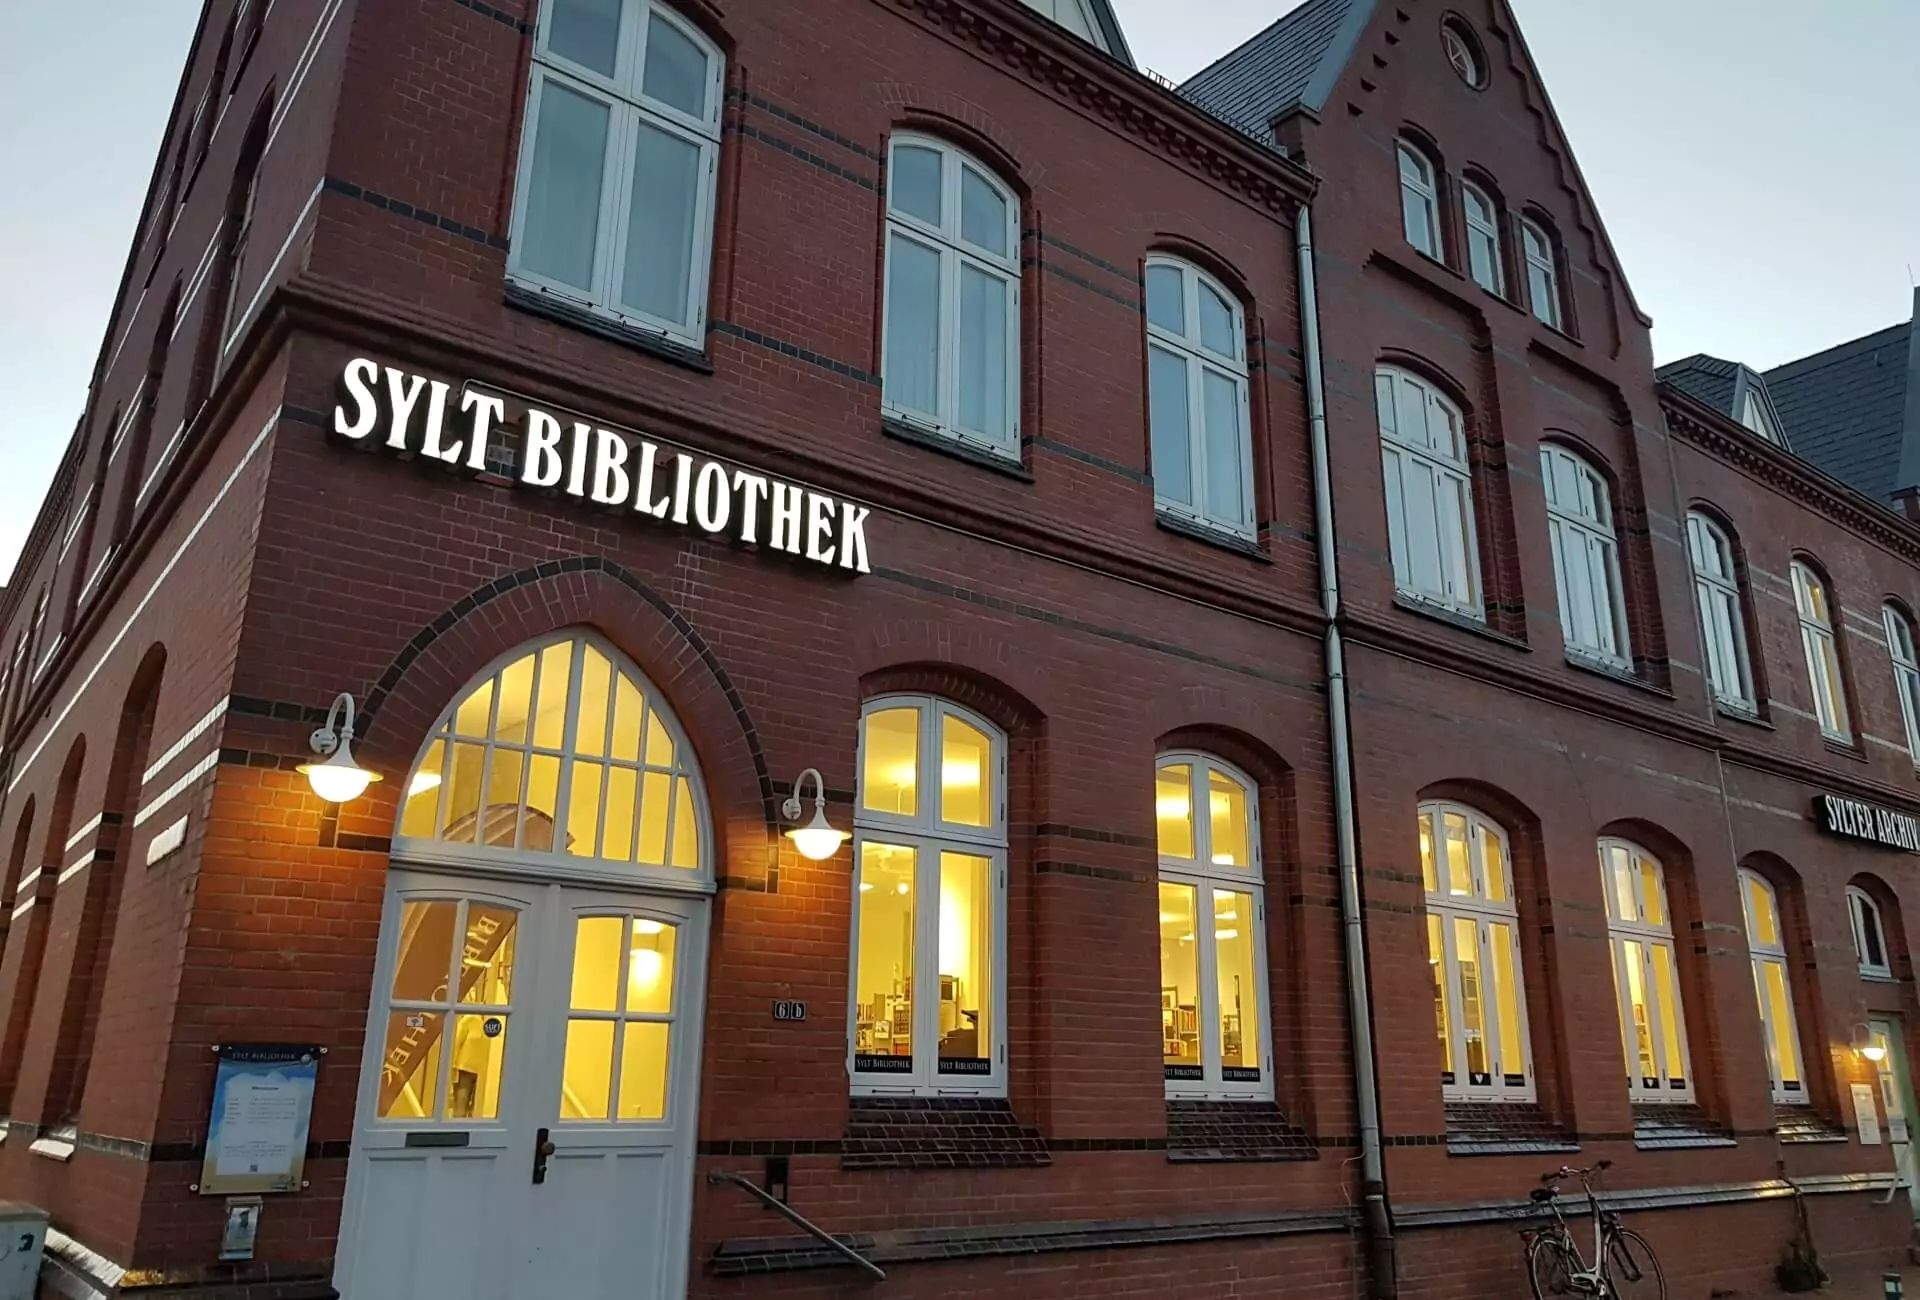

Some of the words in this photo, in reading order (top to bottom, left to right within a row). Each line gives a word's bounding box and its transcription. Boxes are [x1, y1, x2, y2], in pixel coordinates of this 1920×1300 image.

[334, 357, 504, 471] SYLT
[520, 408, 872, 574] BIBLIOTHEK
[1825, 794, 1876, 841] SYLTER
[856, 1058, 872, 1068] SYLT
[873, 1058, 911, 1069] BIBLIOTHEK
[955, 1060, 989, 1070] BIBLIOTHEK
